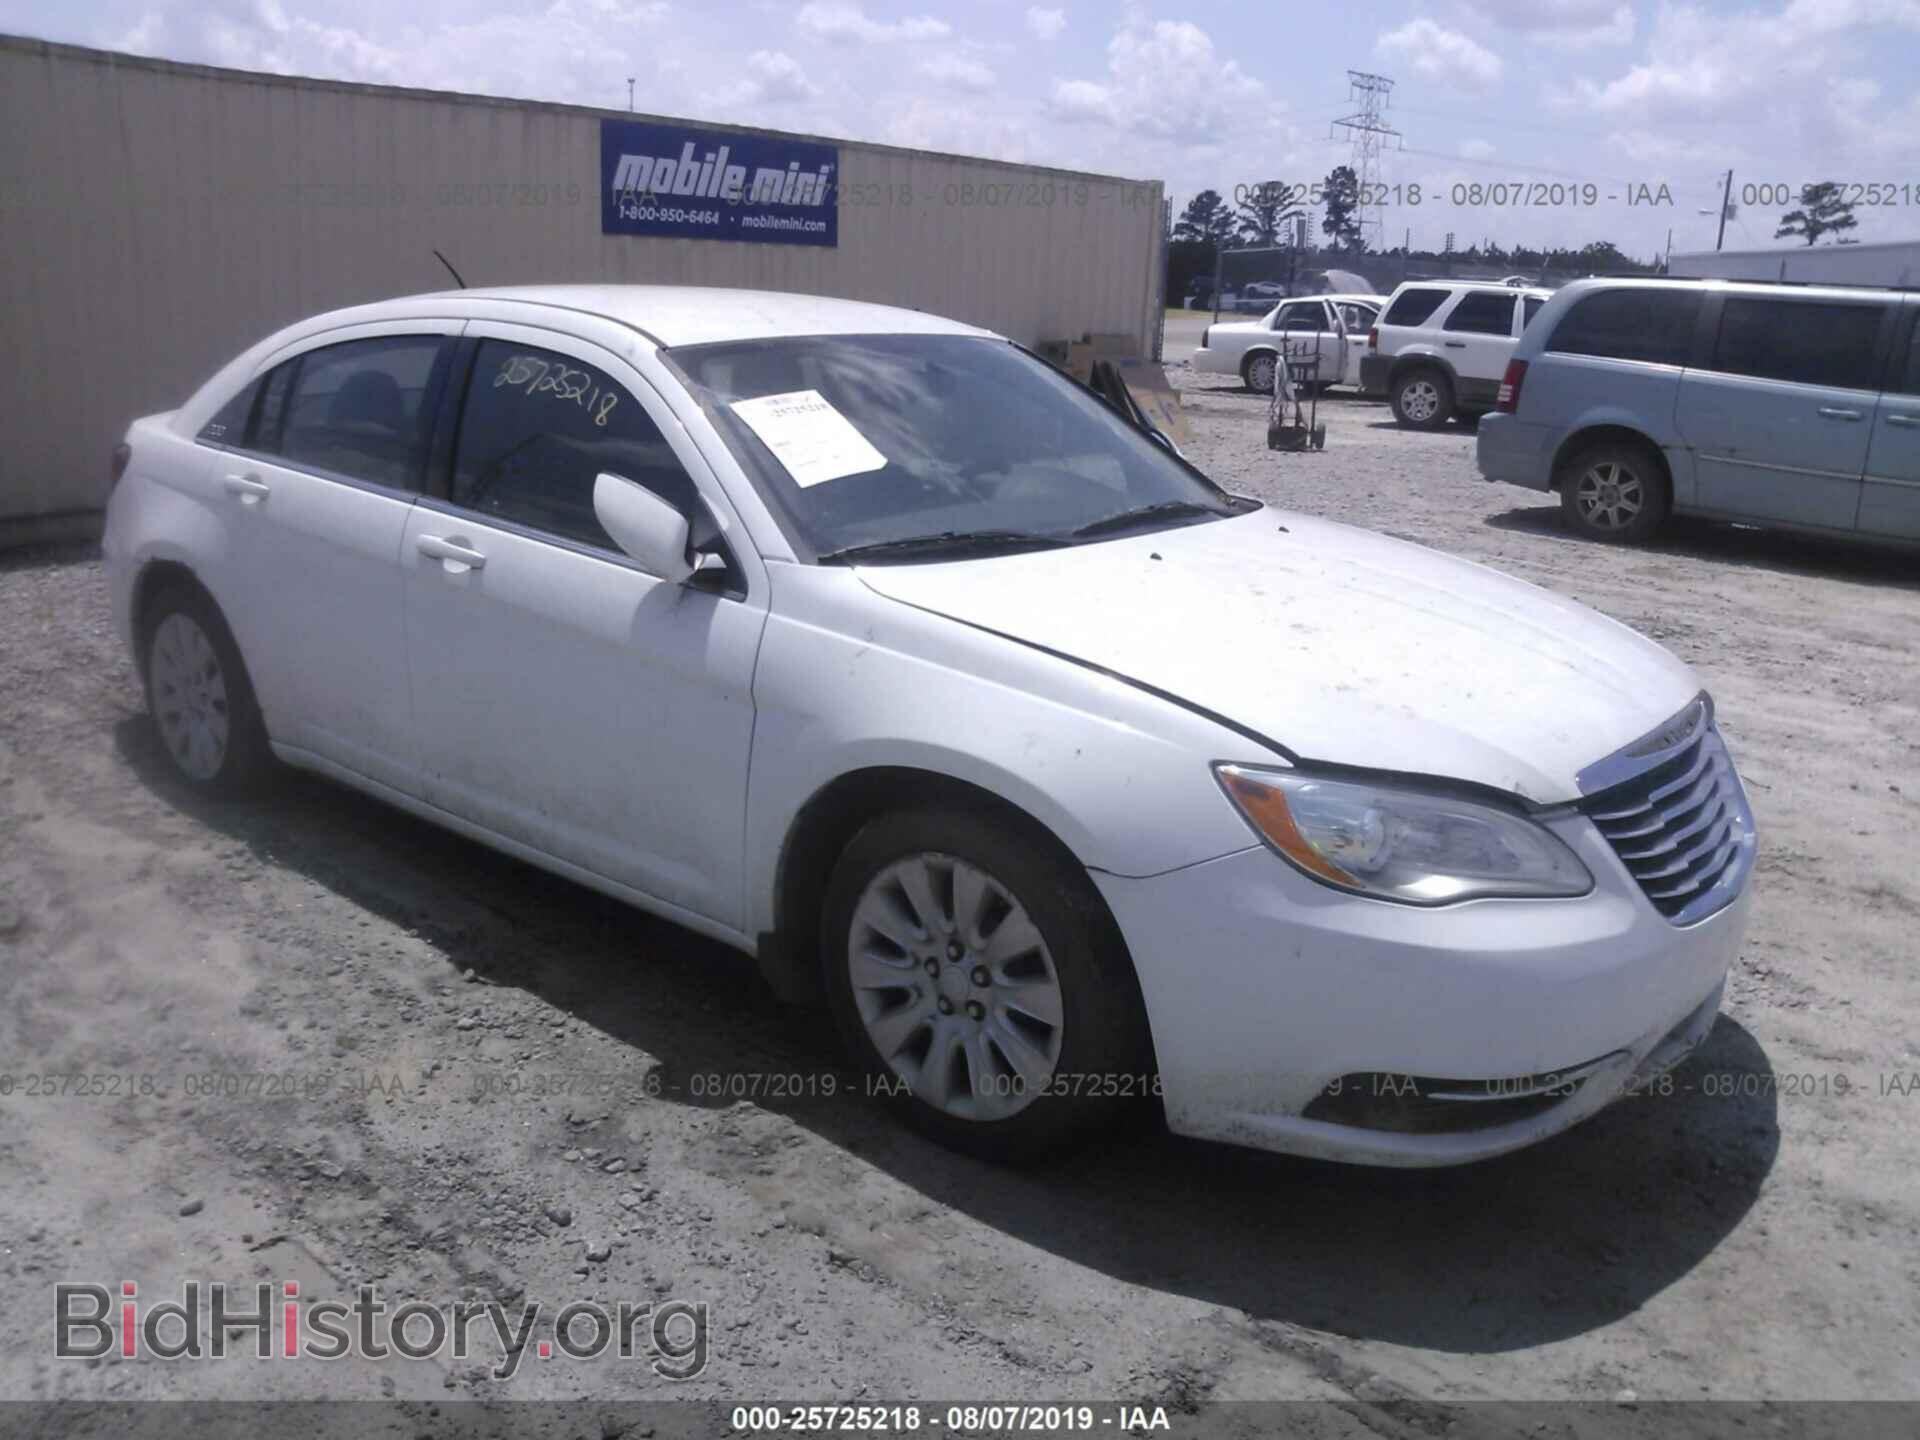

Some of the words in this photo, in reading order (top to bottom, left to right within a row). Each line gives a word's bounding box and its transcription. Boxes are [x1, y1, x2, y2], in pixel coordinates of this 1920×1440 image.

[613, 141, 746, 199] mobile
[750, 161, 830, 207] mini
[619, 206, 720, 225] 1-800-950-6464
[742, 215, 827, 232] mobilemini.com
[493, 355, 618, 426] 25725218
